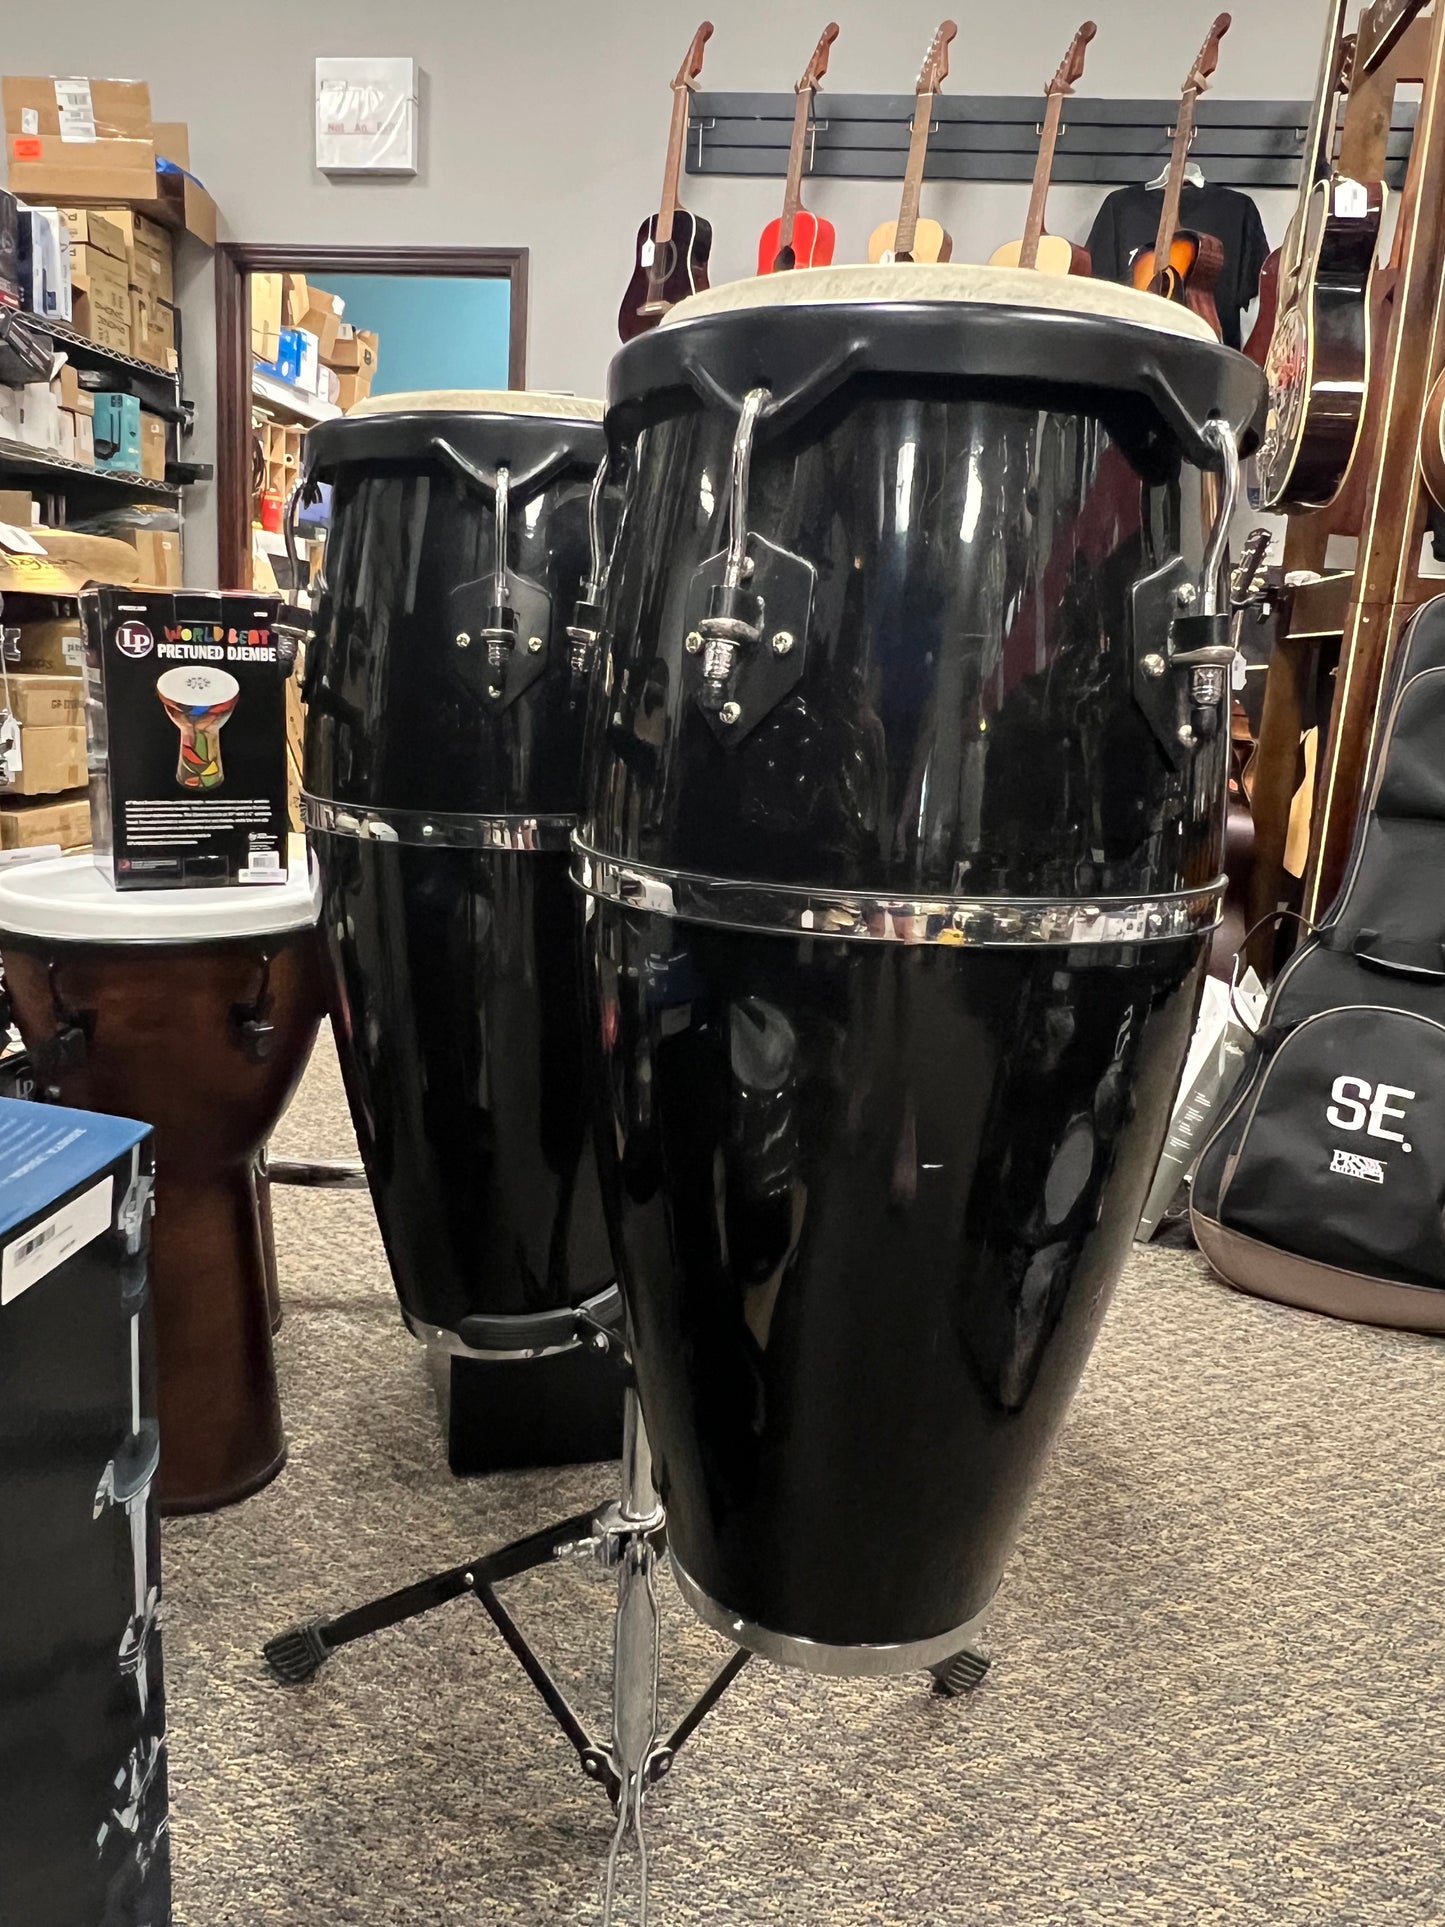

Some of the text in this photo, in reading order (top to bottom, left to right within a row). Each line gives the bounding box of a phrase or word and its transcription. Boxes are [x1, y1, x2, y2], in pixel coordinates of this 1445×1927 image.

[354, 123, 368, 133] An
[122, 628, 150, 653] LP
[164, 625, 270, 645] WORLD BEAT
[157, 643, 277, 662] PRETUNED DJEMBE
